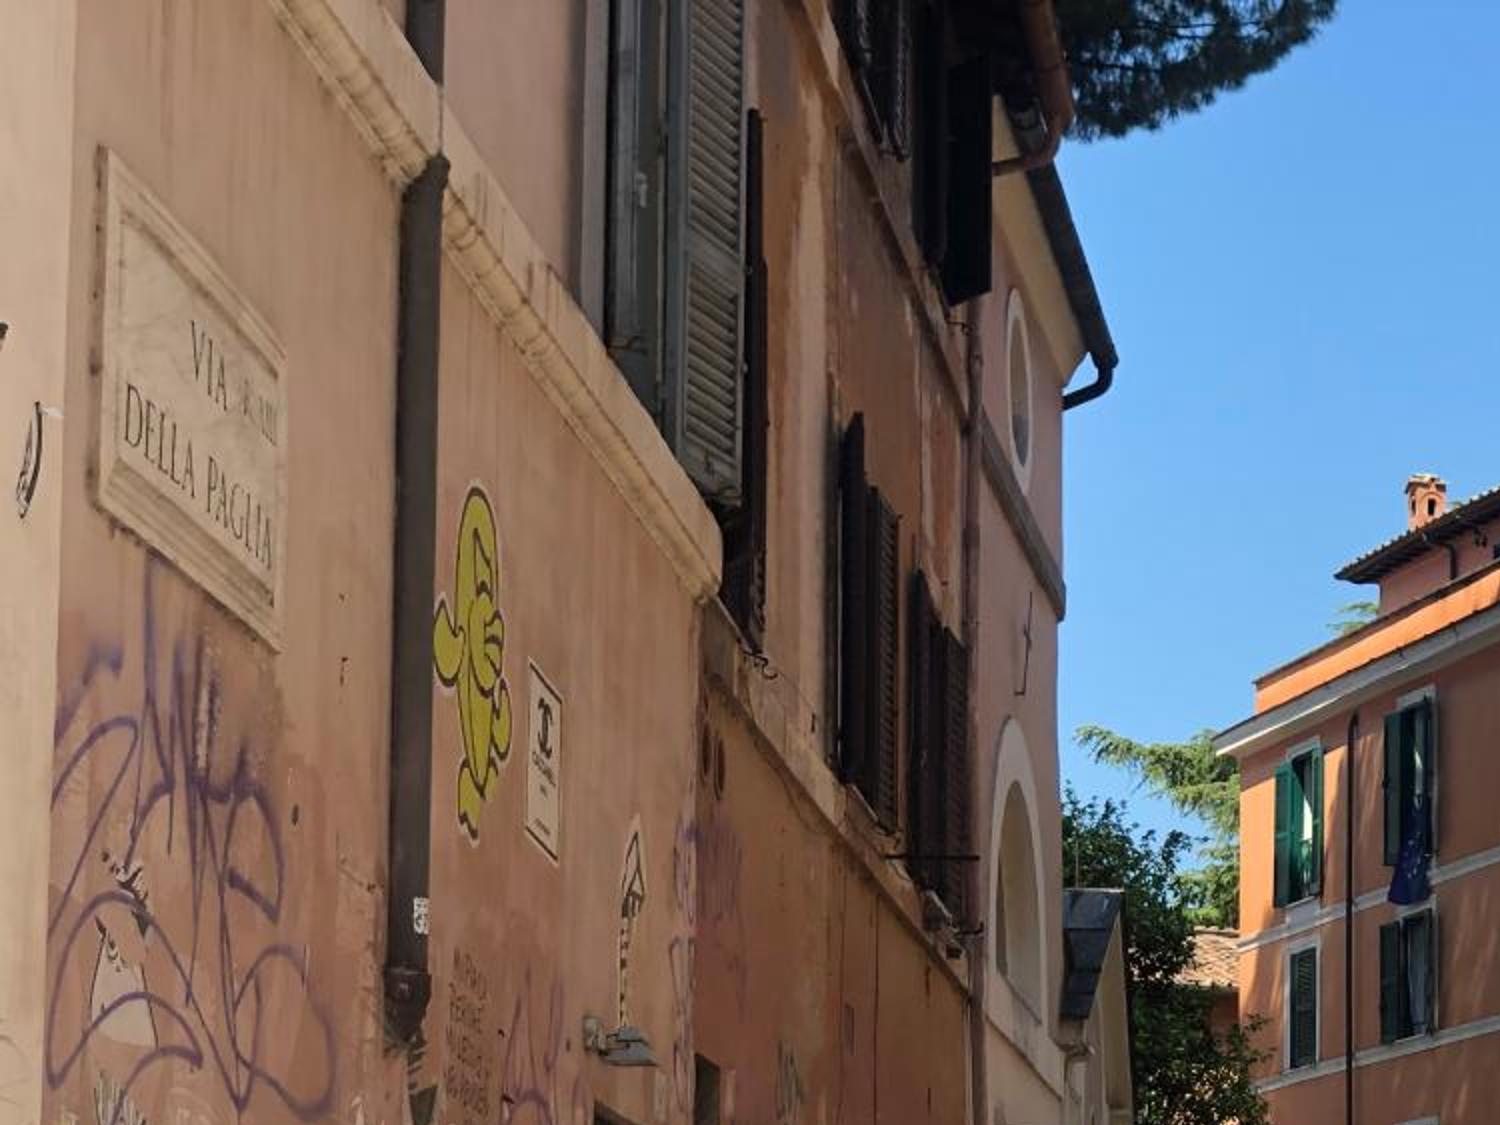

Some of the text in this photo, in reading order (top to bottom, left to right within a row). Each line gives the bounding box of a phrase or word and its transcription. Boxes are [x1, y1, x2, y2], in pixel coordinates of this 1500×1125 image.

[190, 319, 228, 412] VIA
[125, 383, 273, 572] DELLA PAGLIA
